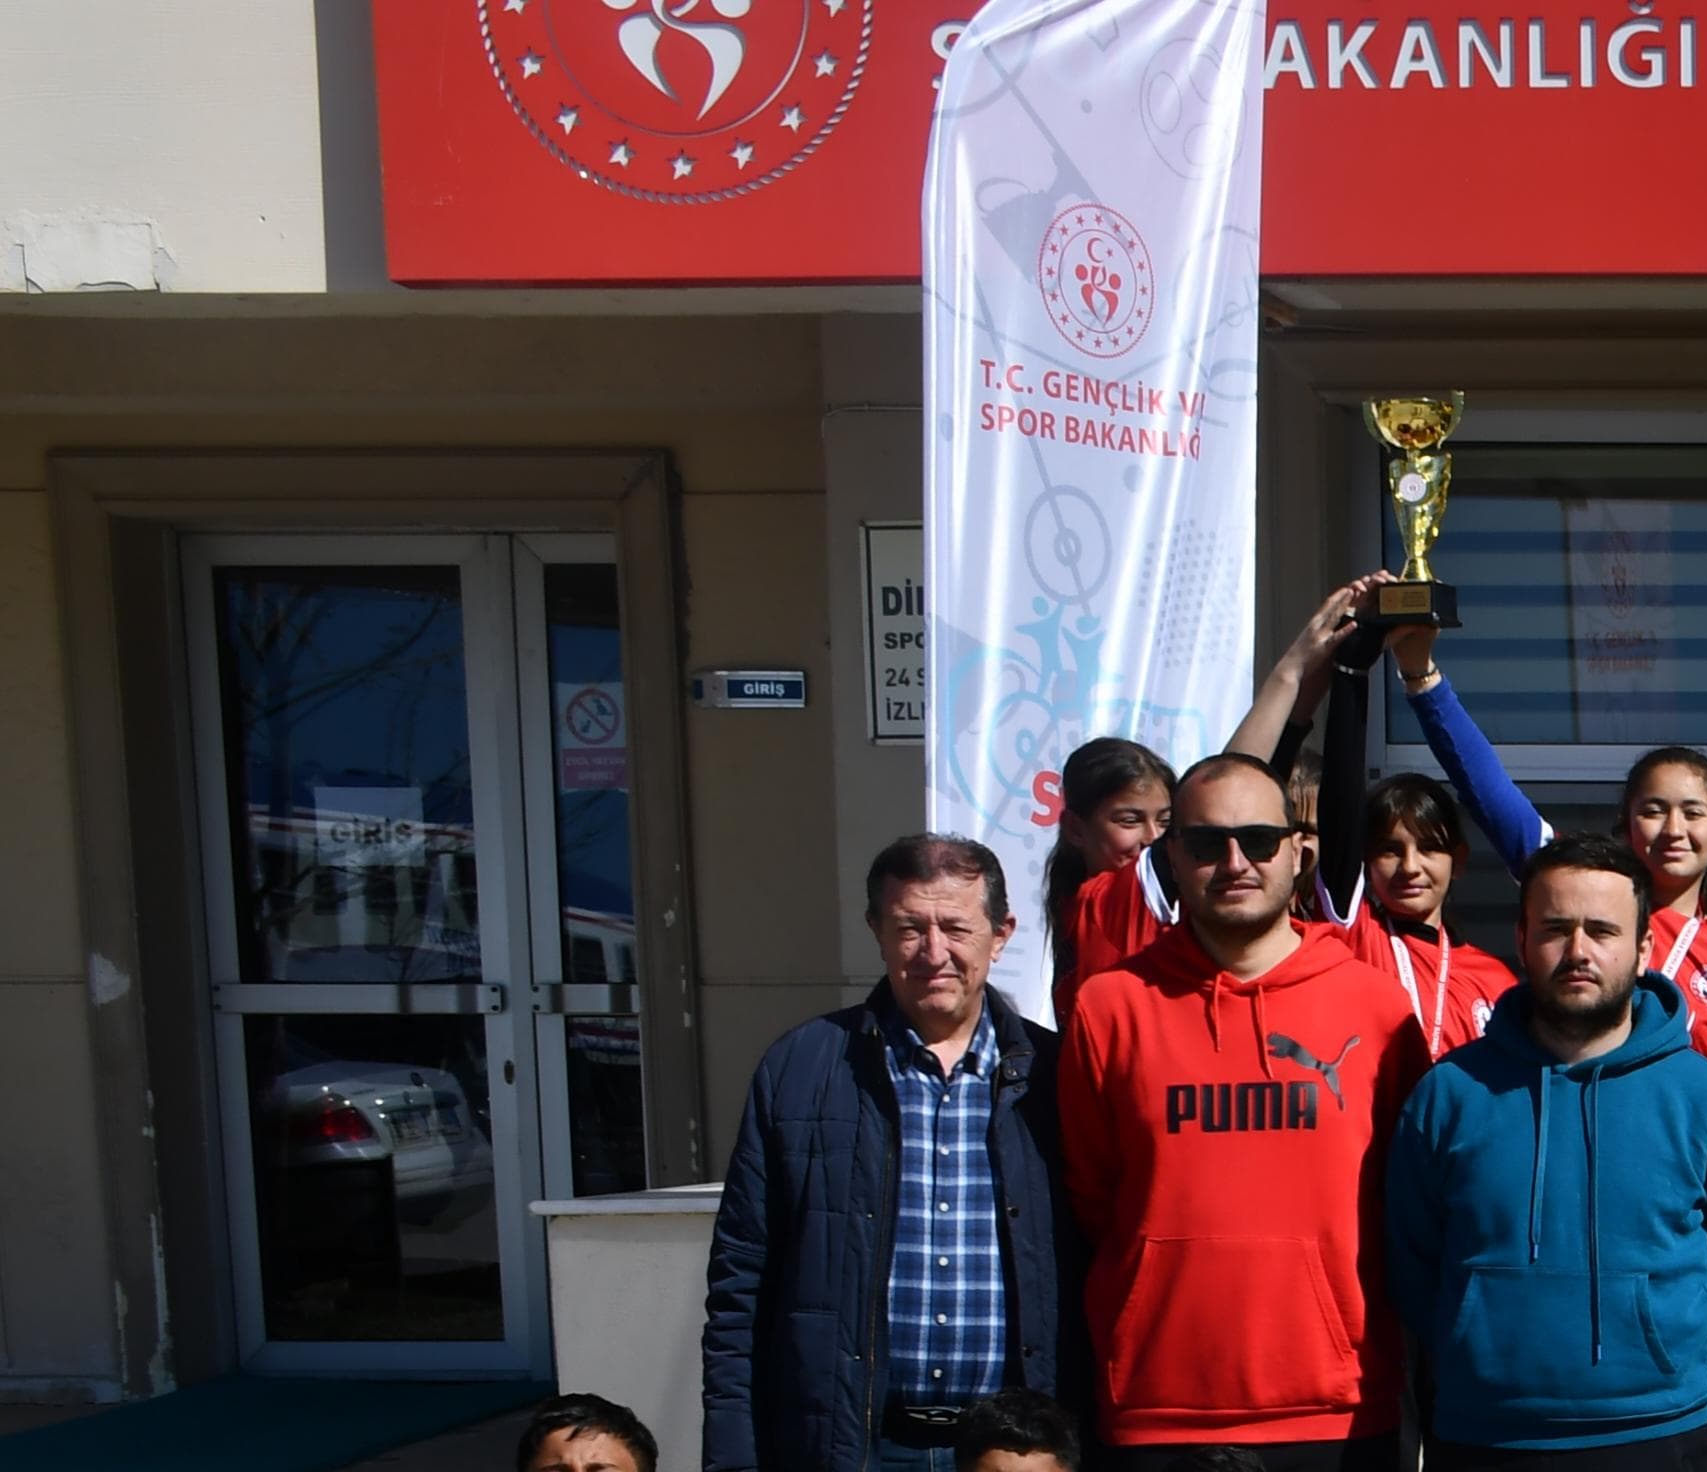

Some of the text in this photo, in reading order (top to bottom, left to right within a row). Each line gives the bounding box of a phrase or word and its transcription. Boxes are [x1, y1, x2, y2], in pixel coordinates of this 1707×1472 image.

[1263, 2, 1698, 90] AKANLIĞI
[980, 359, 1033, 394] T.C.
[1042, 371, 1167, 416] GENÇLİK
[980, 402, 1201, 462] SPOR BAKANLIĞ
[743, 682, 785, 698] GİRİŞ
[885, 669, 911, 687] 24
[1031, 770, 1067, 828] S
[1167, 1080, 1318, 1133] PUMA
